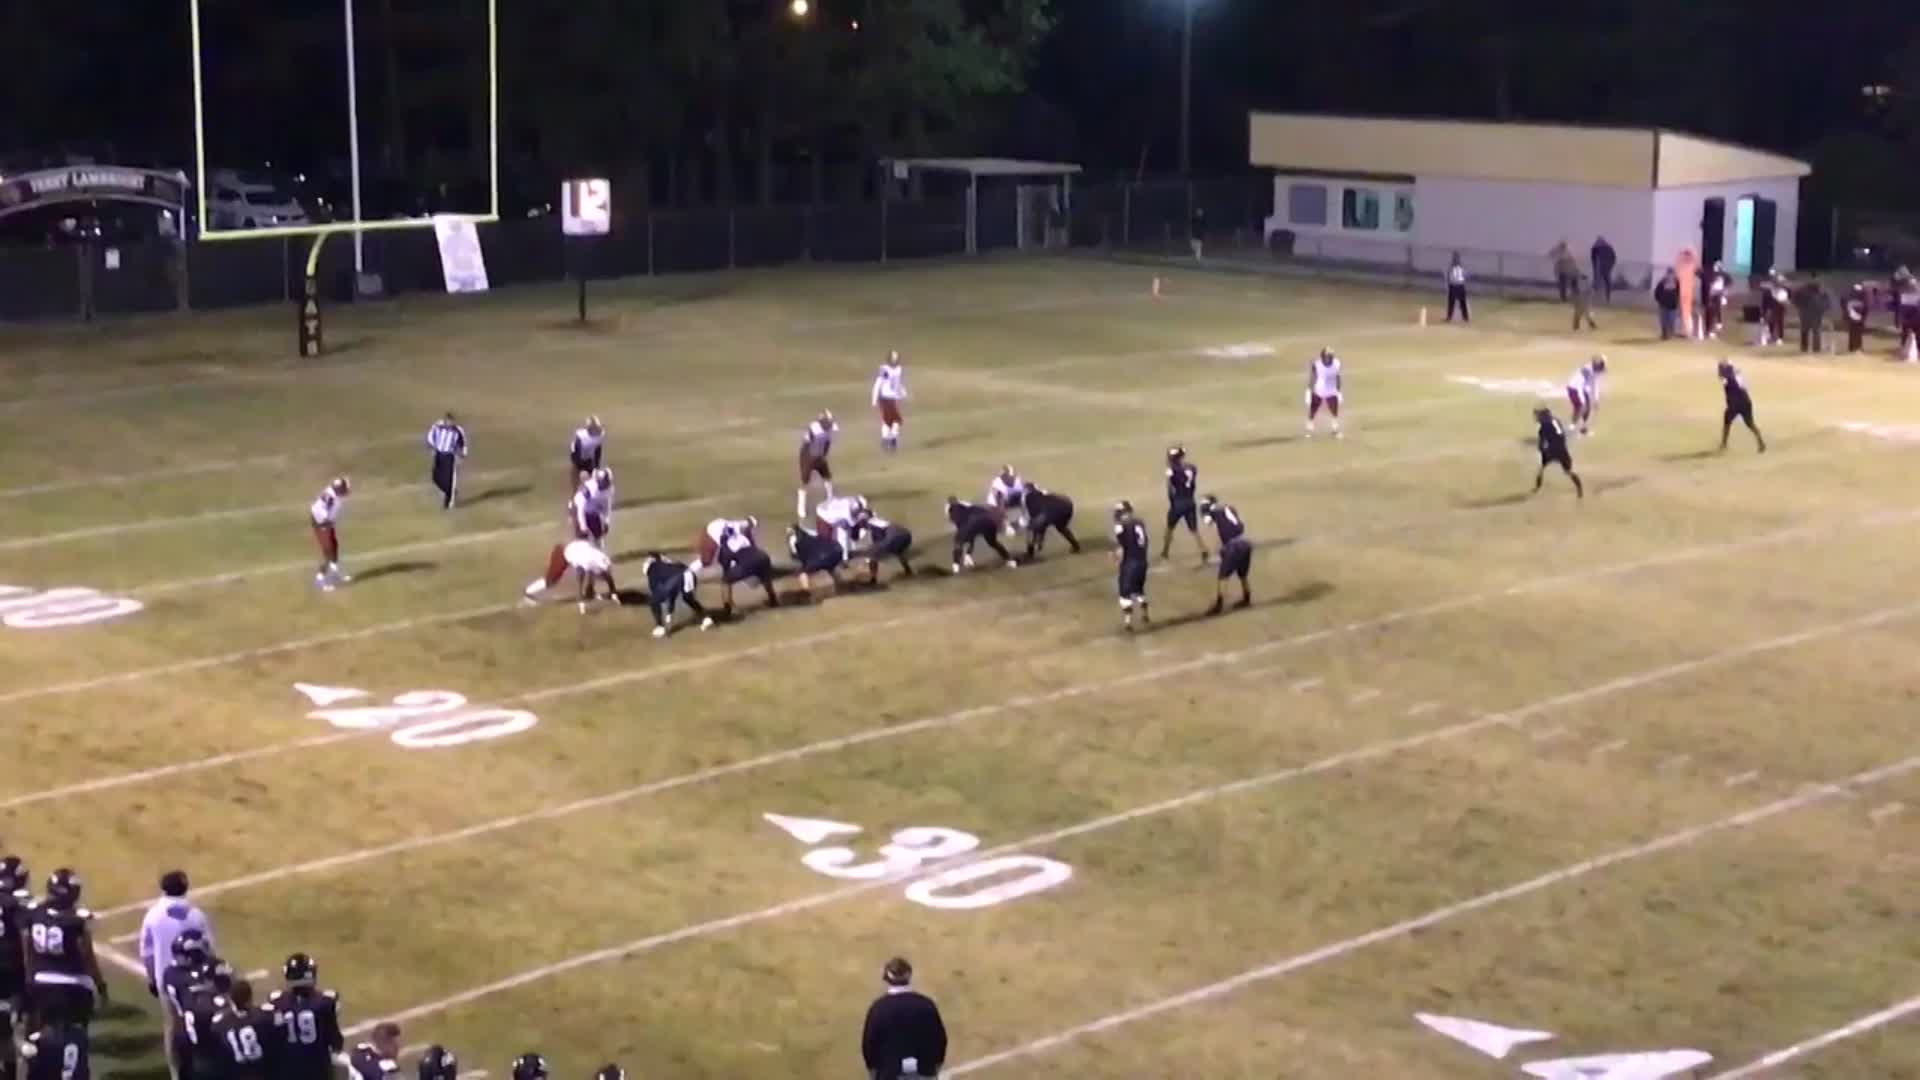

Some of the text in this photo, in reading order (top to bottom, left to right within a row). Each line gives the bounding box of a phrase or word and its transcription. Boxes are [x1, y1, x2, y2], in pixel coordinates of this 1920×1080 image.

[305, 690, 539, 748] 20
[800, 826, 1074, 909] 30
[32, 923, 64, 955] 92
[226, 1025, 264, 1064] 18
